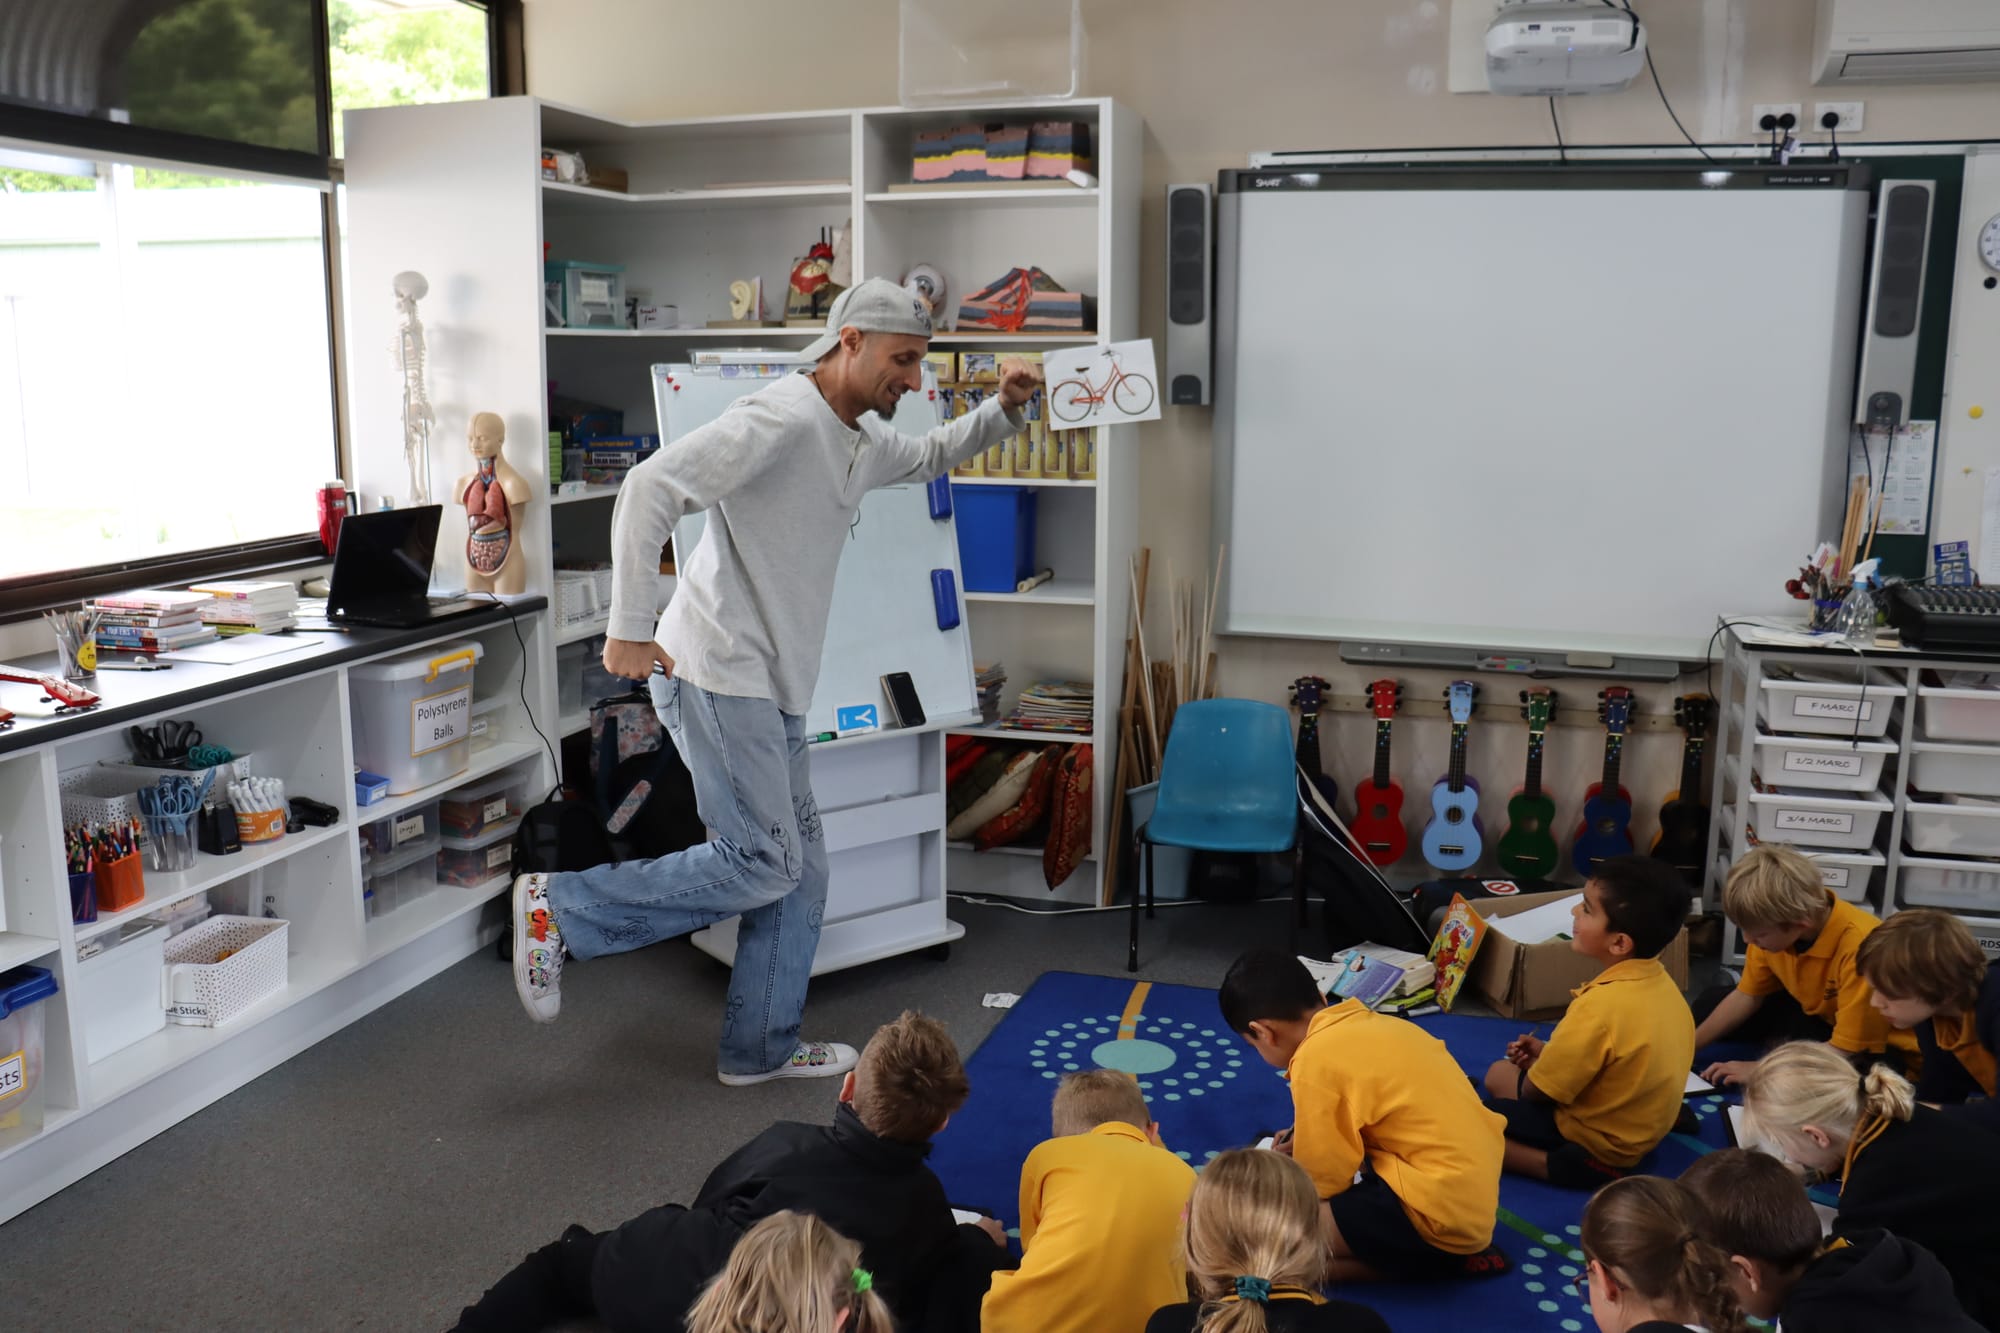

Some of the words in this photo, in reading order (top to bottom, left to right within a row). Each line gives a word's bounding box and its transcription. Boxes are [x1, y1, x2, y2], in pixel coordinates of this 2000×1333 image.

[417, 696, 468, 720] Polystyrene
[1820, 703, 1855, 712] MARC
[433, 723, 454, 741] Balls
[1796, 757, 1815, 765] 1/2
[1816, 759, 1850, 768] MARC
[1786, 815, 1806, 823] 3/4
[1808, 817, 1842, 826] MARC
[179, 1006, 208, 1015] Sticks
